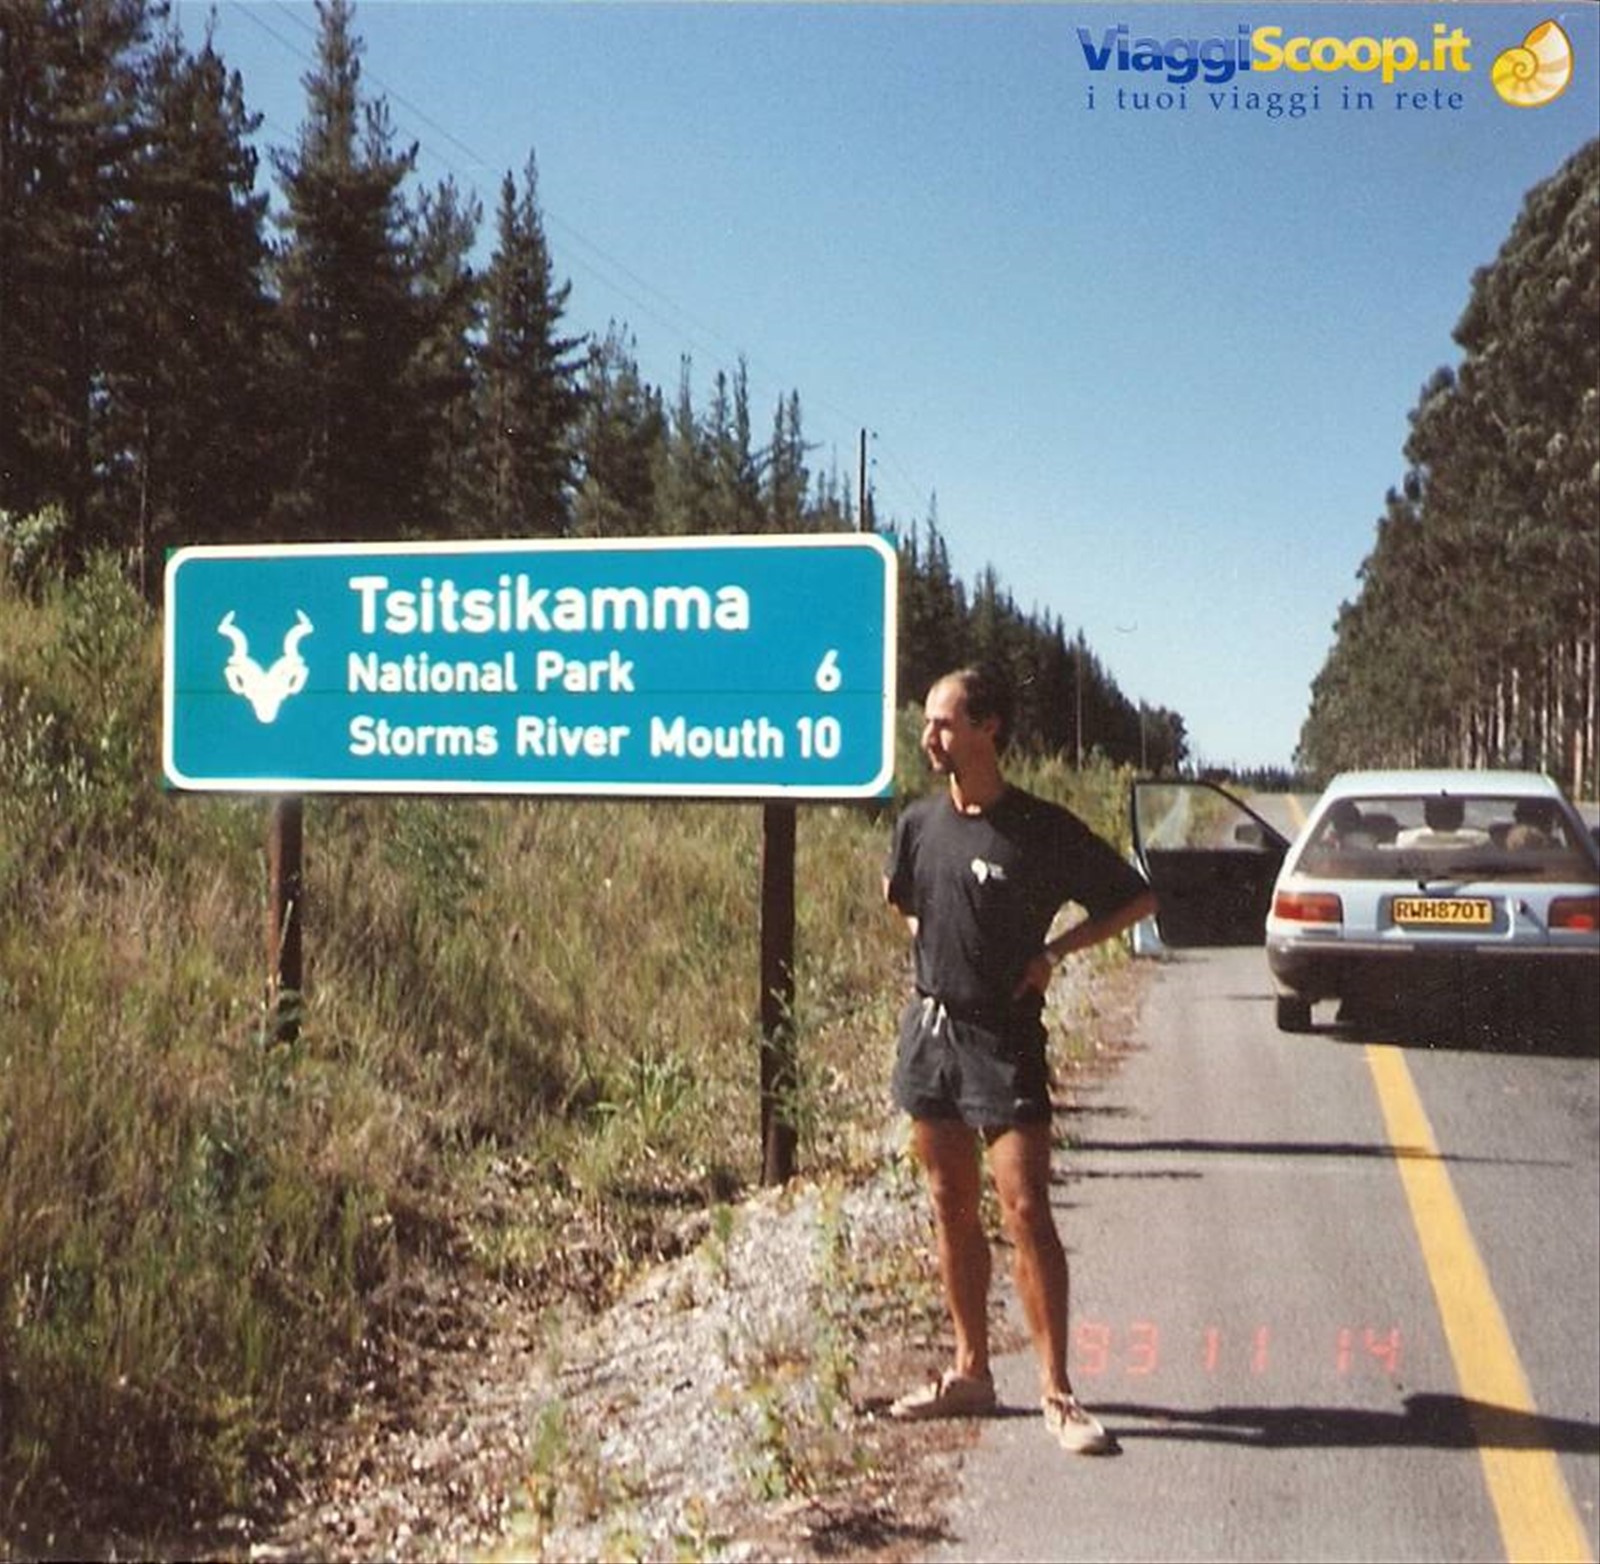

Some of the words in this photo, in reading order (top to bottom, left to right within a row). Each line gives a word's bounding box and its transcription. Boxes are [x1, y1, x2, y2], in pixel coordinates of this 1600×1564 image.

[349, 574, 750, 634] Tsitsikamma
[348, 651, 517, 693] National
[536, 651, 635, 692] Park
[815, 650, 841, 692] 6
[349, 715, 499, 757] Storms
[516, 715, 630, 757] River
[650, 716, 784, 759] Mouth
[796, 716, 841, 759] 10
[1396, 901, 1487, 919] RWH870T
